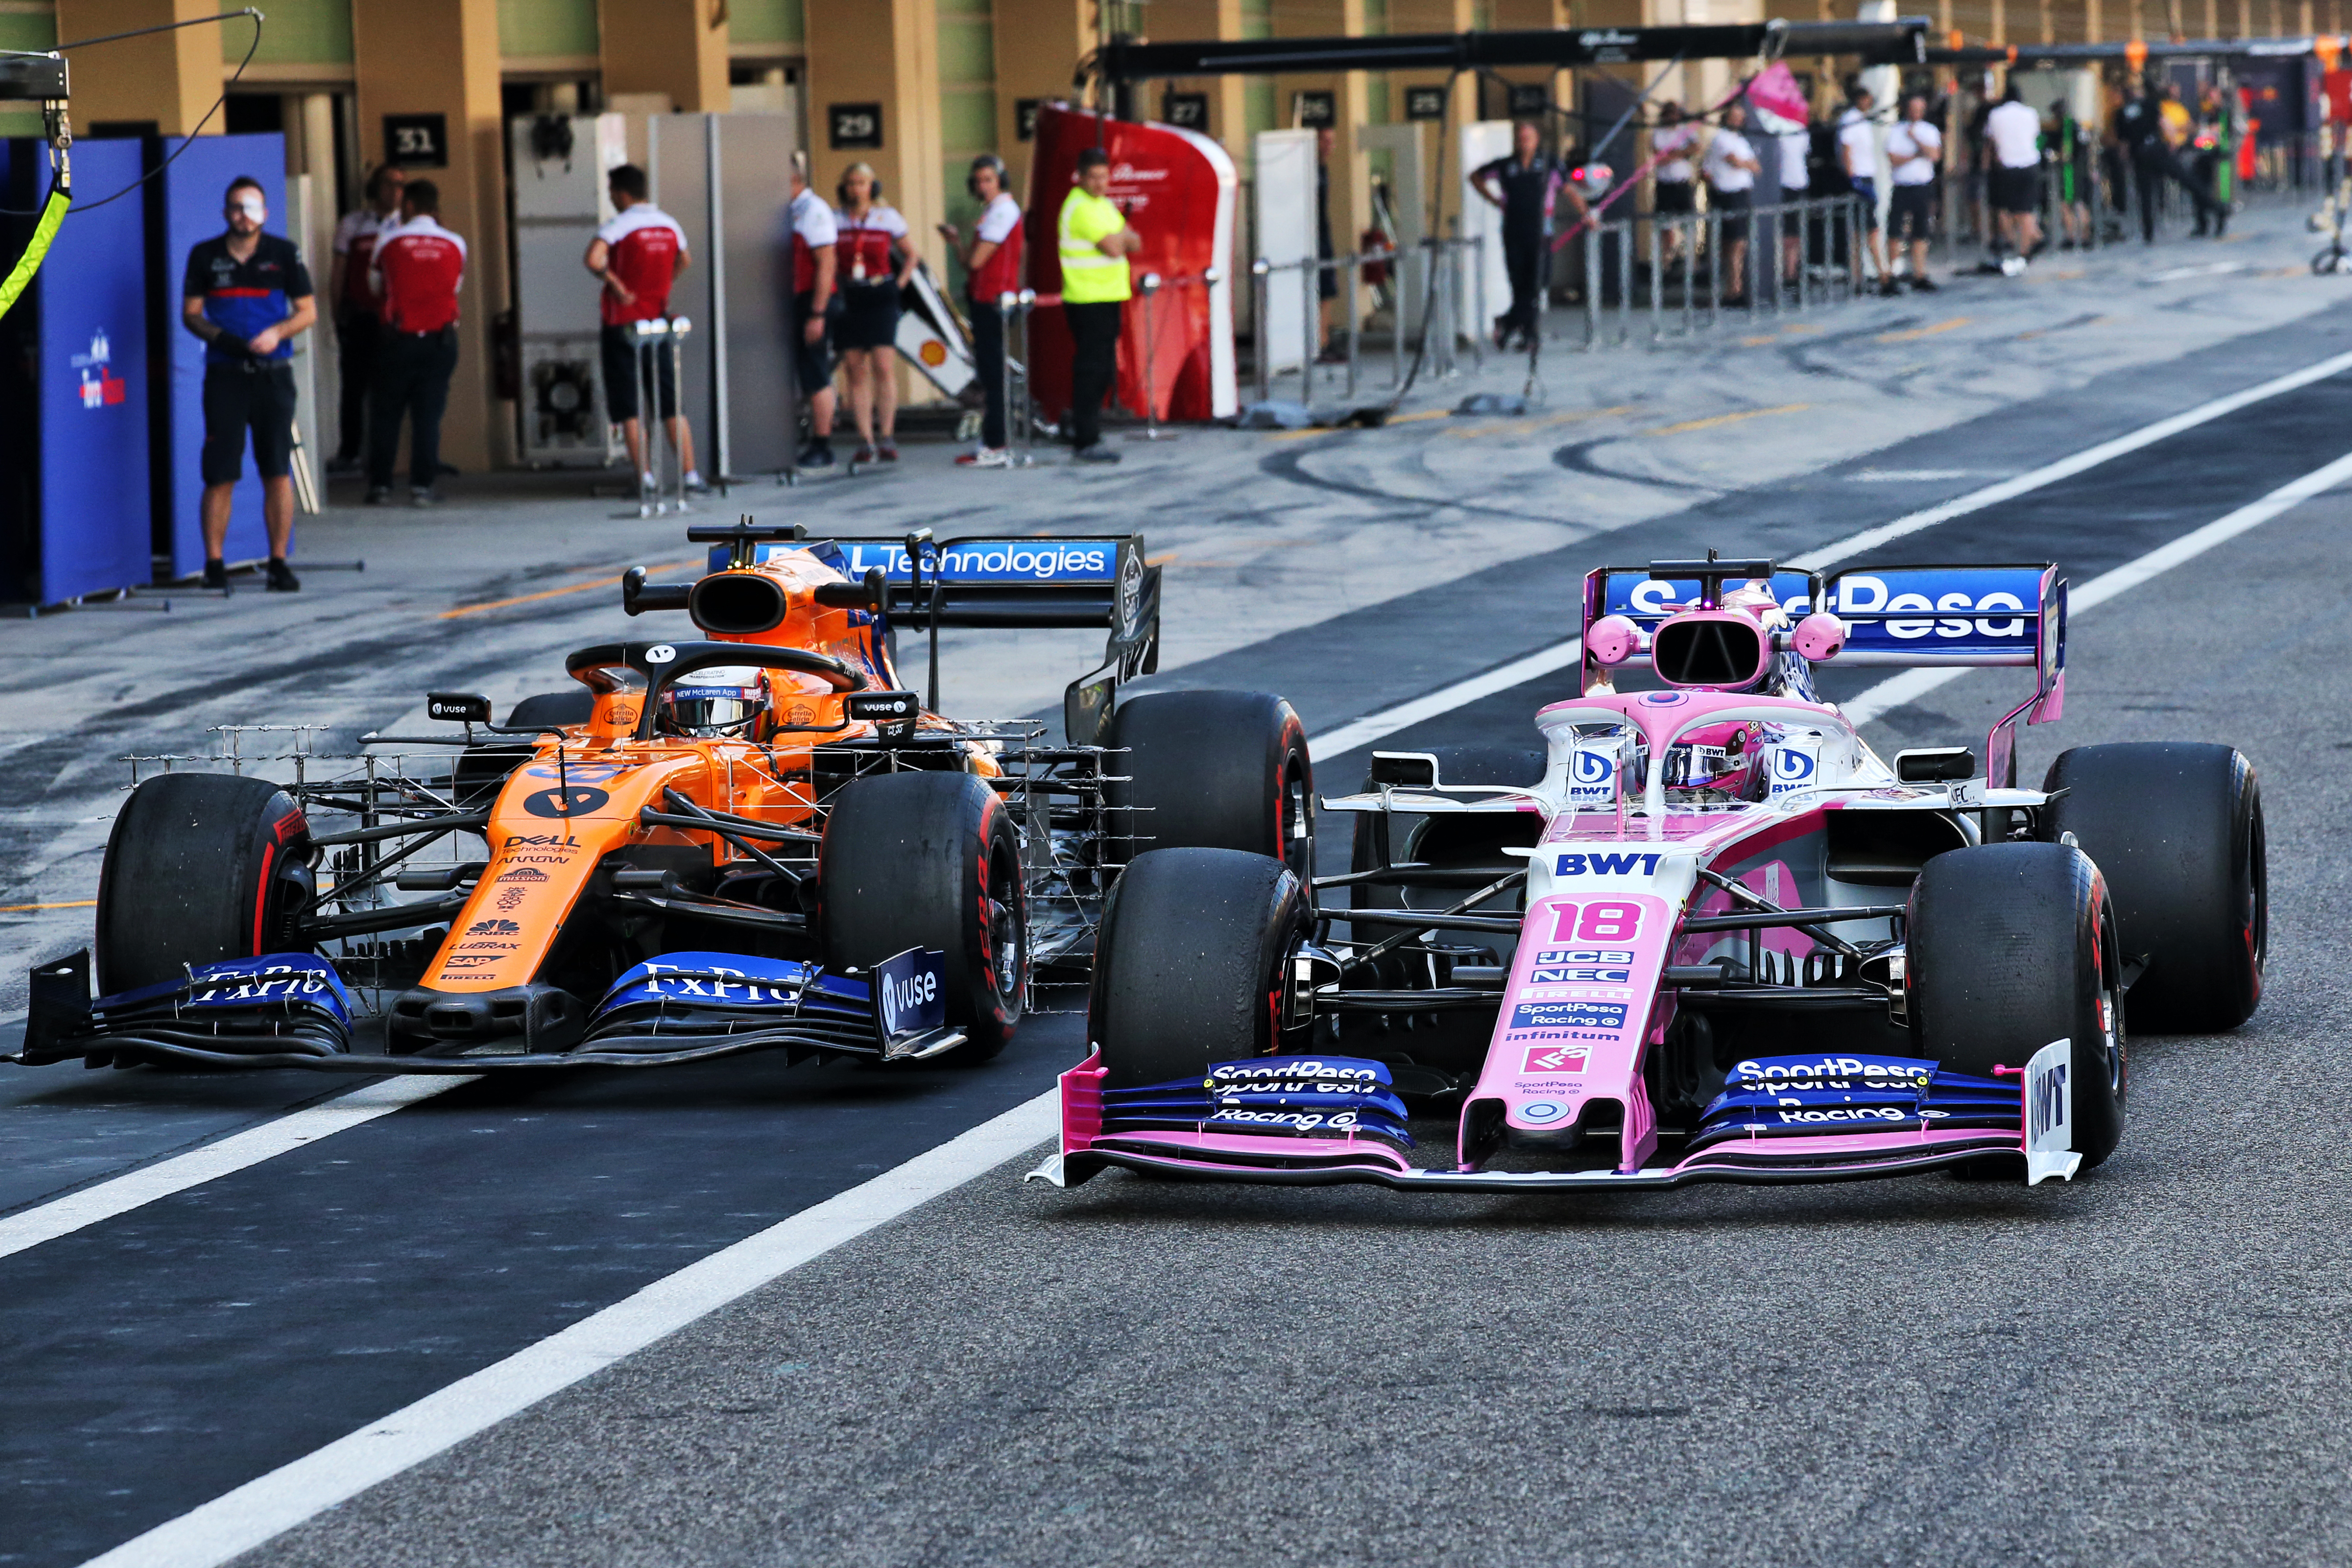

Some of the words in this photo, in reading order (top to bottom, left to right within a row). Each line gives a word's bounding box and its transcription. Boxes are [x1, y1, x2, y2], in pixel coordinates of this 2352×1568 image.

[837, 114, 874, 136] 29
[397, 128, 434, 153] 31
[880, 545, 1104, 578] Technologies
[676, 689, 691, 698] NEW
[744, 687, 761, 696] HUSKI
[444, 704, 466, 713] vuse
[1706, 748, 1725, 756] BWT
[503, 835, 581, 848] DELL
[503, 846, 578, 854] Technologies
[496, 856, 570, 865] ARROW
[1555, 853, 1662, 876] BWT
[1544, 900, 1647, 945] 18
[447, 957, 491, 965] SAP
[1538, 951, 1632, 964] JCB
[1533, 969, 1628, 982] NEC
[896, 971, 936, 1013] vuse
[1519, 986, 1635, 1000] PIRELLI
[1519, 1003, 1623, 1014] SportPesa
[1531, 1015, 1597, 1026] Racing
[1505, 1031, 1620, 1041] infinitum
[1213, 1061, 1377, 1096] SportPesa
[1737, 1058, 1931, 1096] SportPesa
[1210, 1098, 1323, 1131] Racing
[1778, 1098, 1905, 1123] Racing
